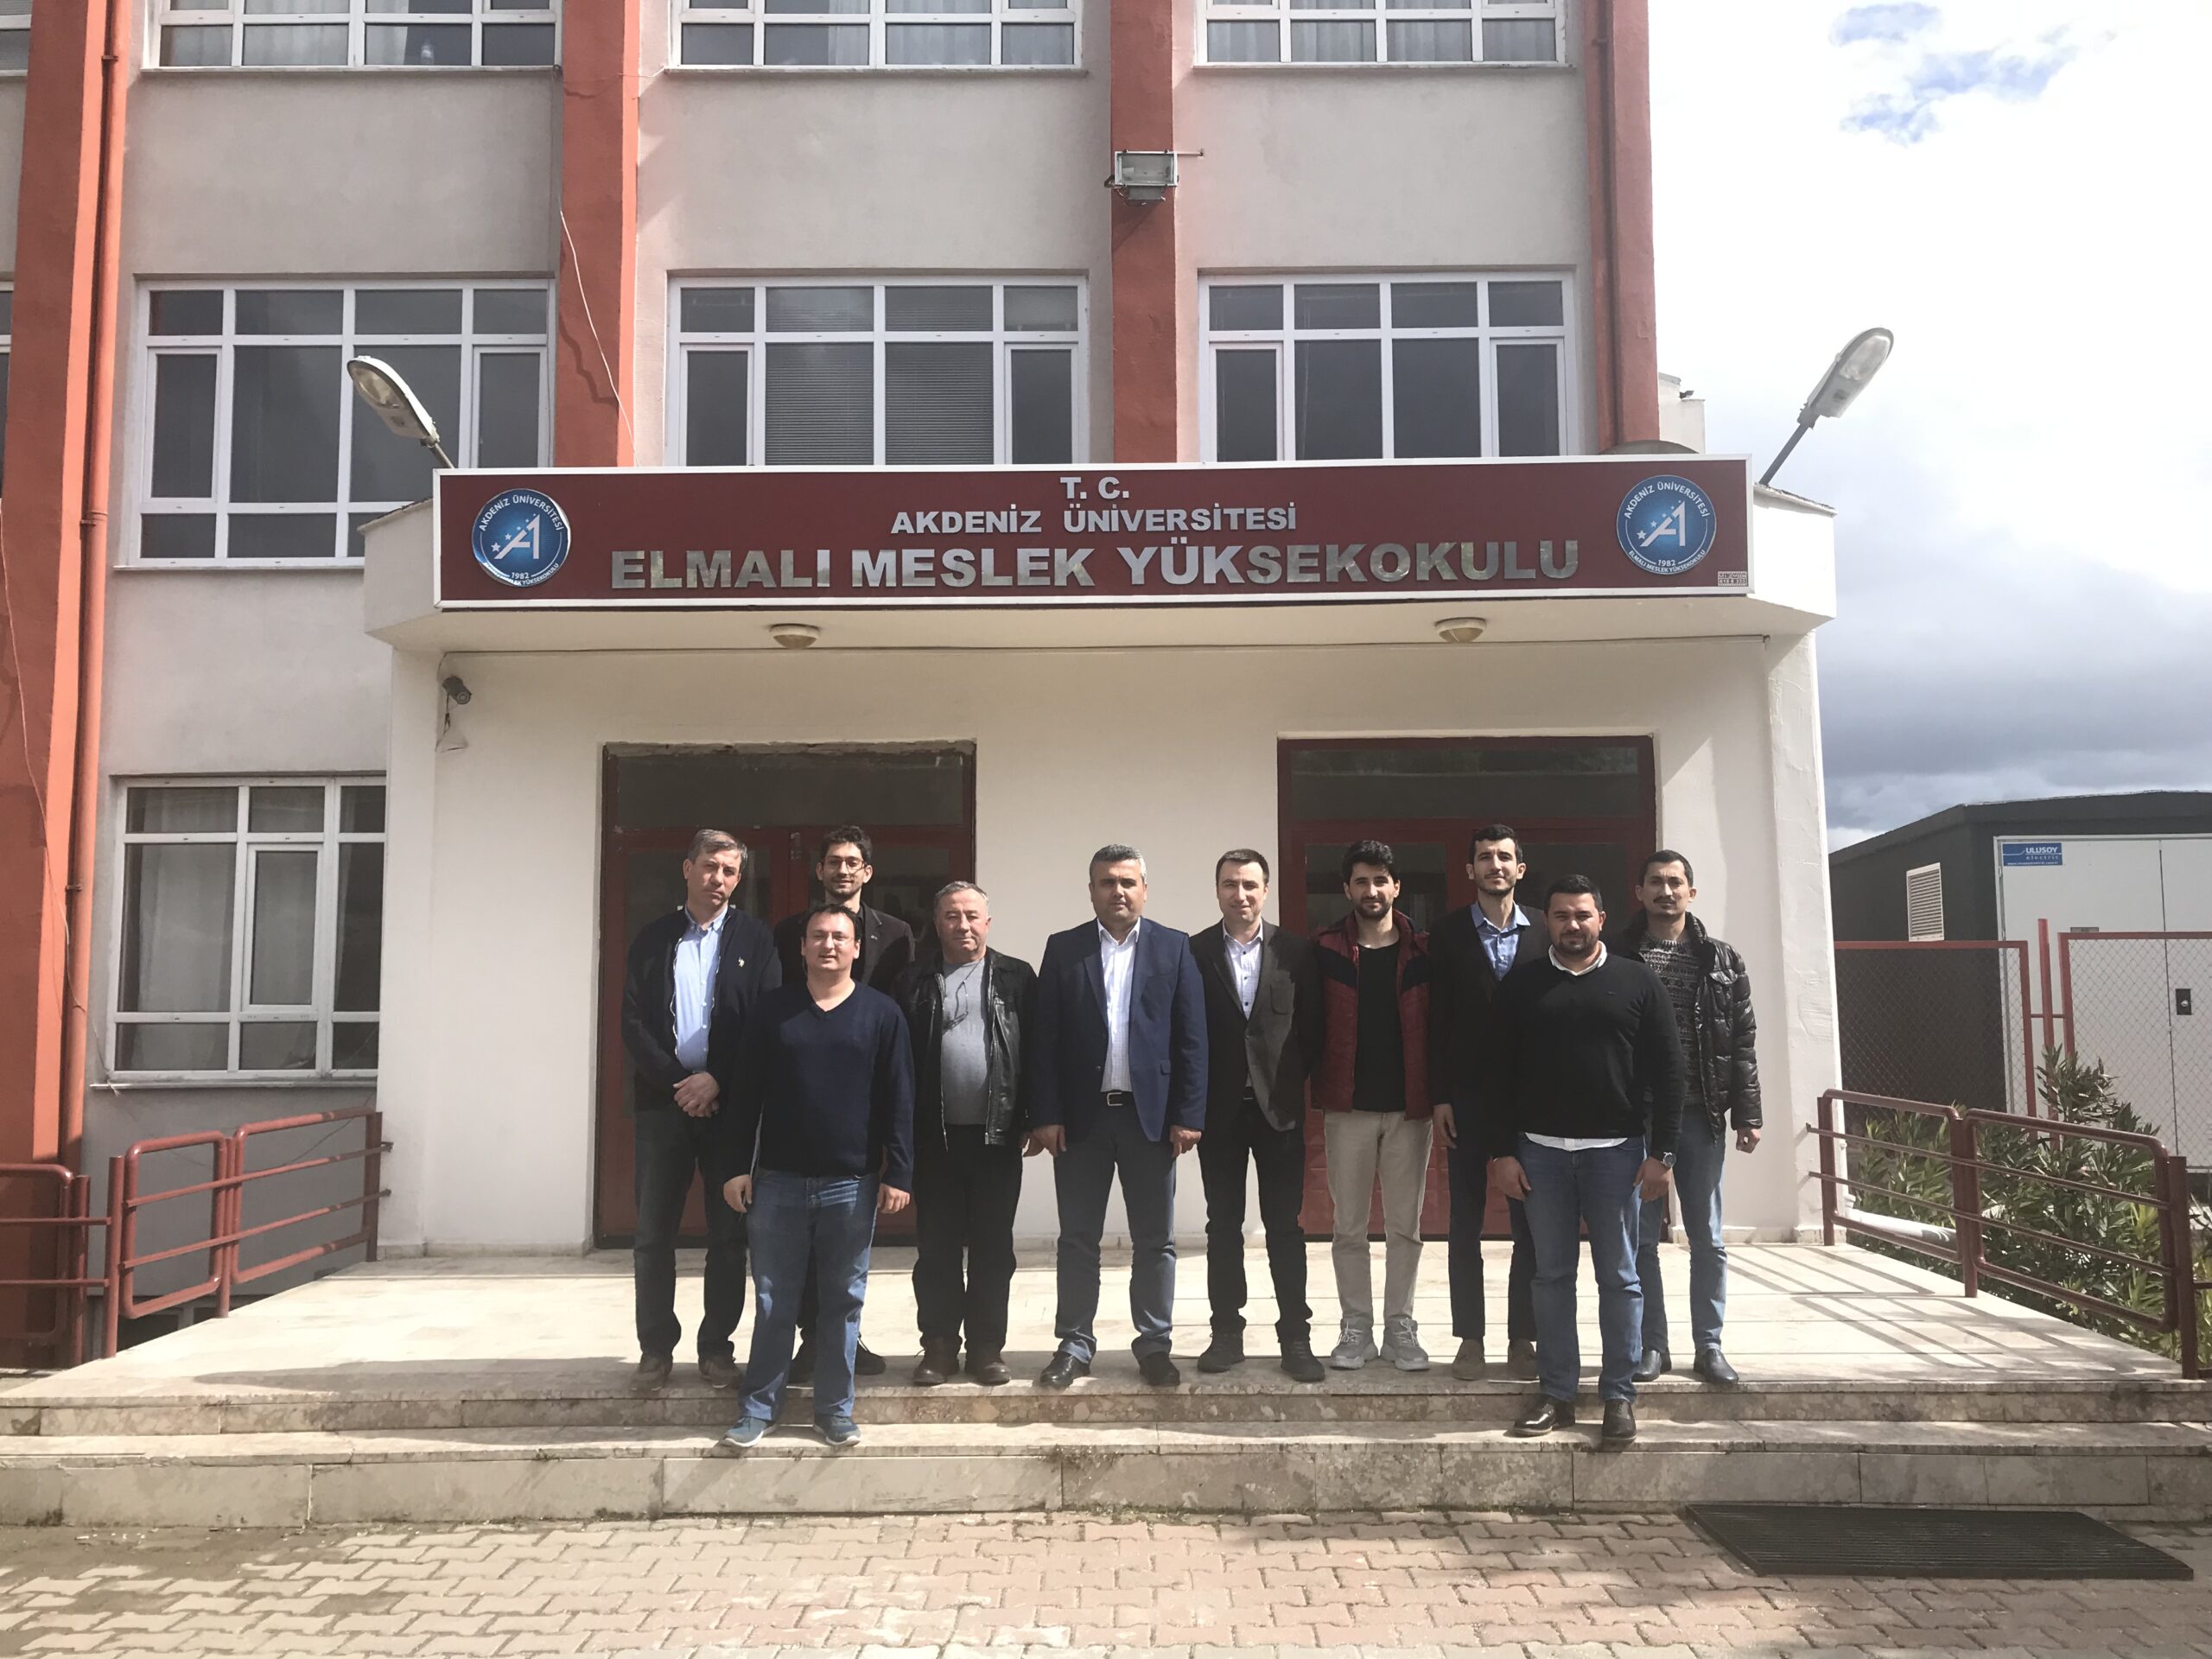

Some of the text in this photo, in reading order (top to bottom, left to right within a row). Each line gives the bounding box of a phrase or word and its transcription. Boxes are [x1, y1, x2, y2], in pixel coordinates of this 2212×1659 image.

[1059, 476, 1129, 499] T. C.
[1624, 481, 1711, 519] AKDENİZ ÜNİVERSİTESİ
[478, 494, 564, 531] AKDENİZ ÜNİVERSİTESİ
[891, 501, 1295, 533] AKDENİZ ÜNİVERSİTESİ
[512, 571, 530, 580] 1982
[611, 536, 1580, 588] ELMALI MESLEK YÜKSEKOKULU
